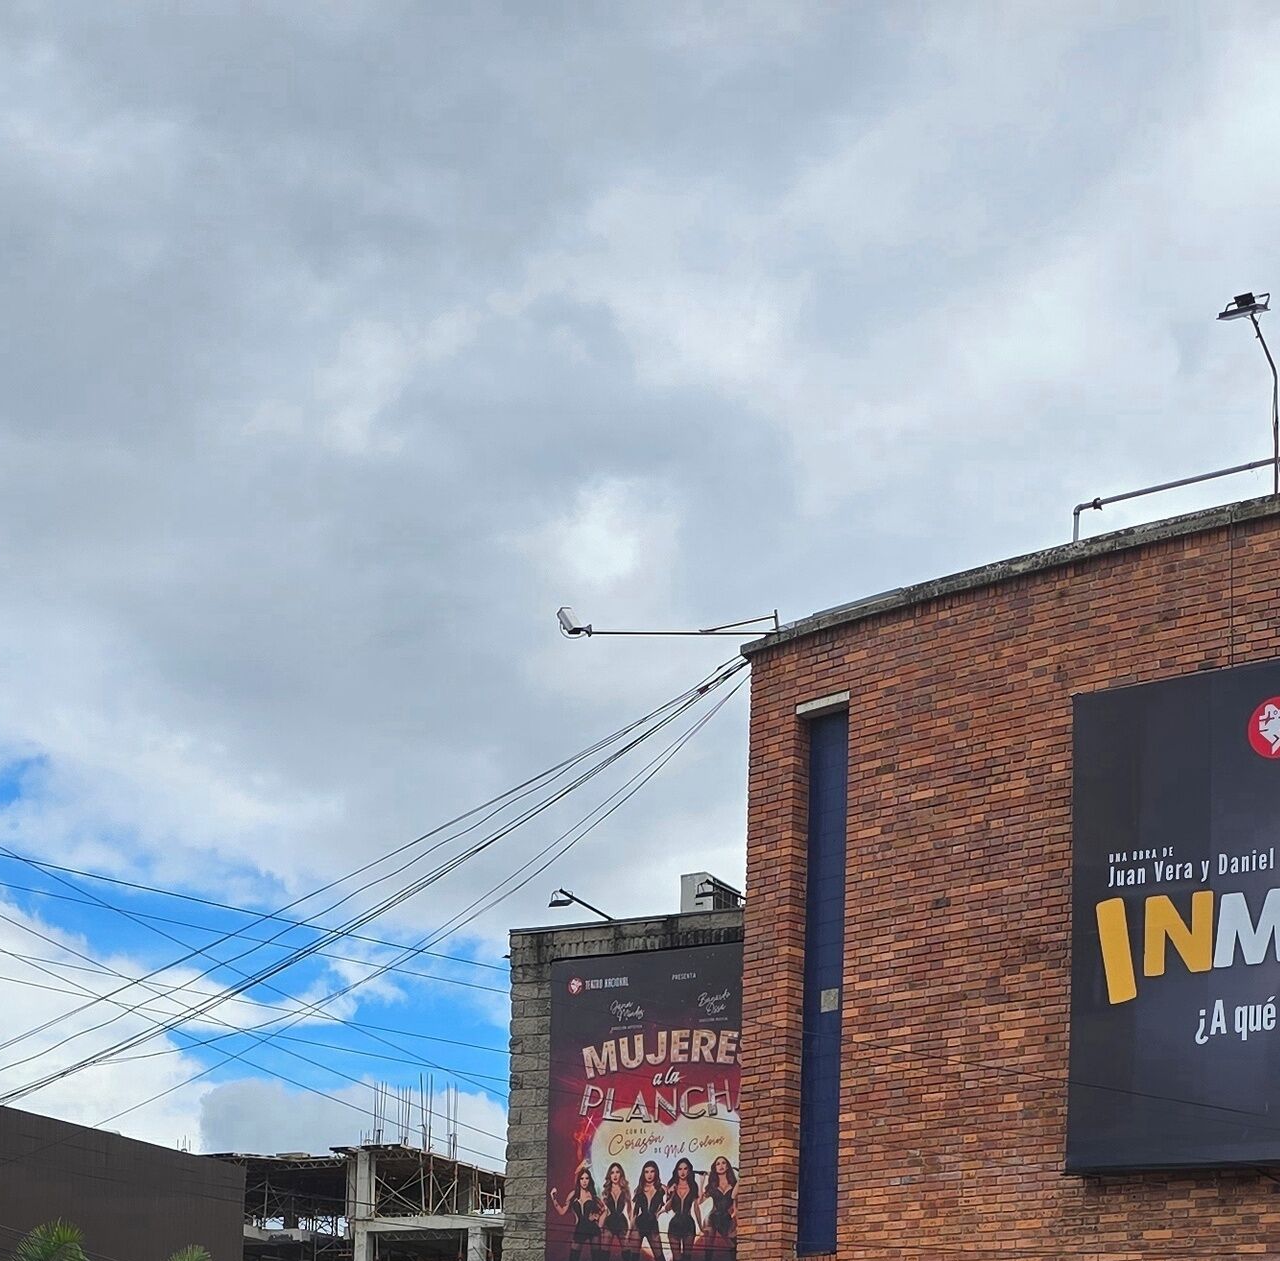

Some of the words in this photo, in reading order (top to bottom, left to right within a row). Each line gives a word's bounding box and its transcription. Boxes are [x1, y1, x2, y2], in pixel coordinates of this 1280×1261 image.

[1108, 866, 1146, 888] Juan
[1154, 860, 1193, 883] Vera
[1200, 859, 1210, 882] y
[1218, 848, 1274, 875] Daniel
[1109, 853, 1128, 863] UNA
[1132, 849, 1157, 861] OBRA
[1162, 846, 1174, 858] DE
[1194, 999, 1227, 1045] ¿A
[1234, 995, 1276, 1041] qué
[582, 1029, 742, 1080] MUJERE
[579, 1079, 741, 1124] PLANCH
